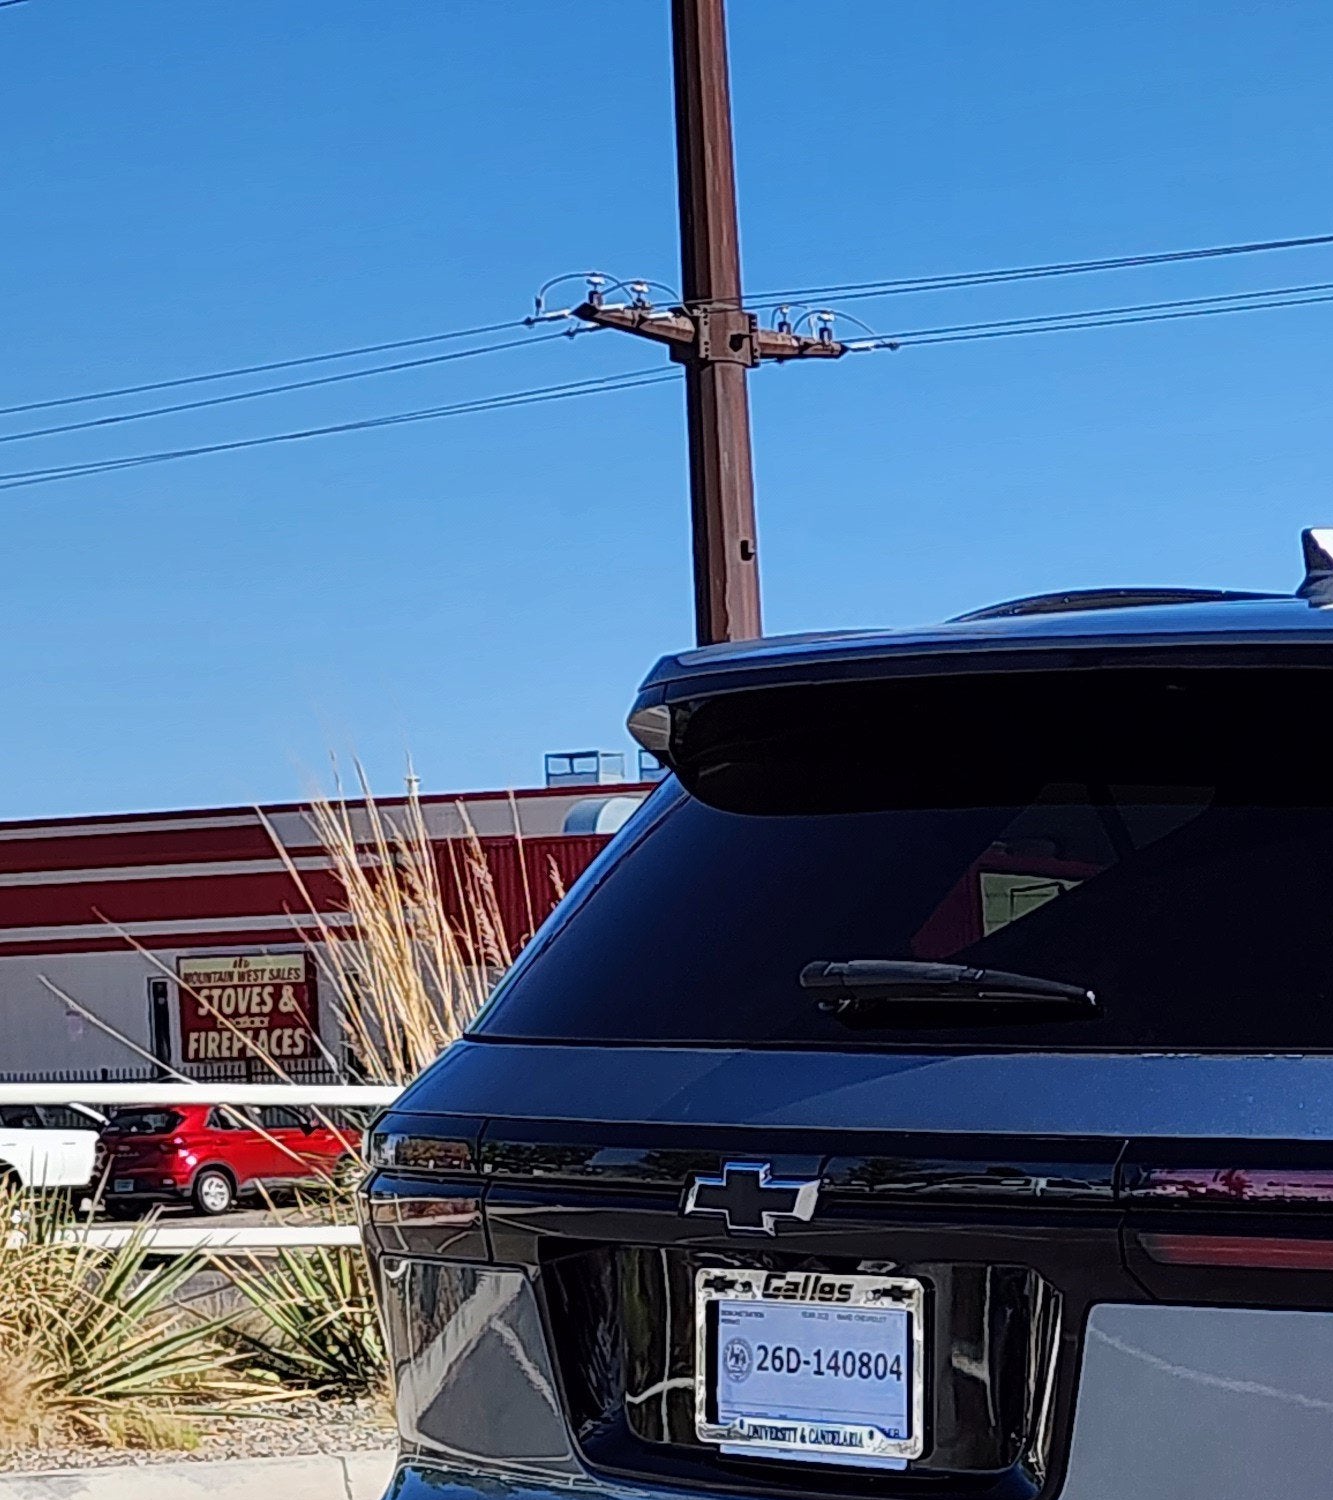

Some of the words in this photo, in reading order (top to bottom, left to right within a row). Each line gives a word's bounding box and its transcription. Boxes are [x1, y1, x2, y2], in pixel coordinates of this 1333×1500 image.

[237, 968, 266, 983] WEST
[268, 967, 301, 981] SALES
[198, 985, 274, 1016] STOVES
[278, 985, 295, 1013] &
[188, 1027, 305, 1060] FIREPLACES
[762, 1273, 854, 1302] Galles
[756, 1344, 902, 1382] 26D-140804
[747, 1424, 798, 1444] UNIVERSITY
